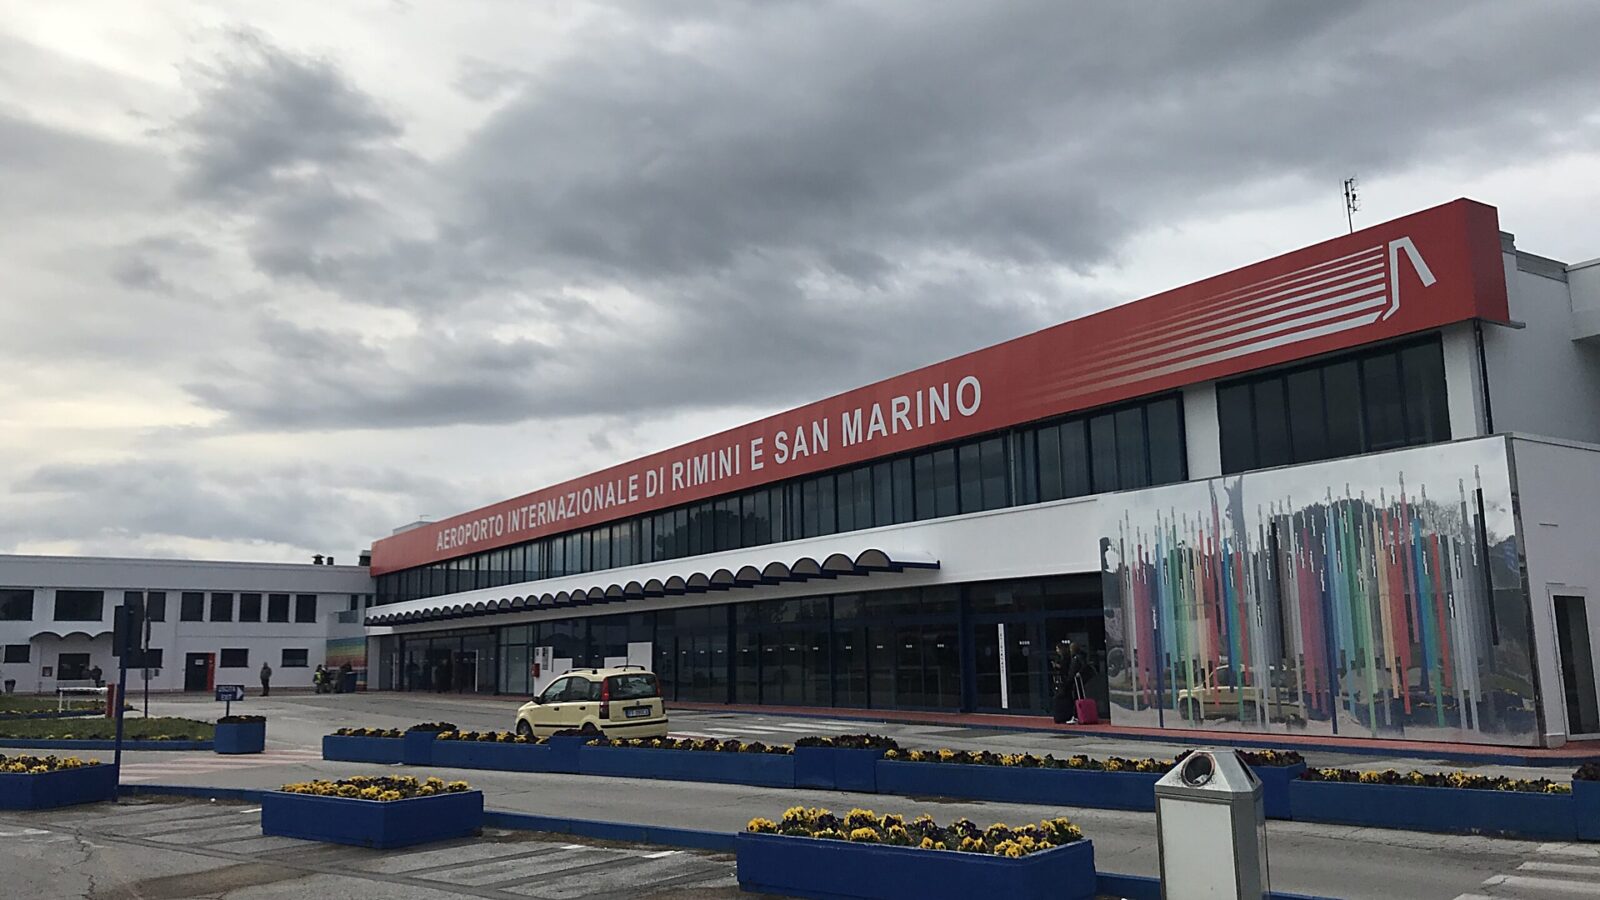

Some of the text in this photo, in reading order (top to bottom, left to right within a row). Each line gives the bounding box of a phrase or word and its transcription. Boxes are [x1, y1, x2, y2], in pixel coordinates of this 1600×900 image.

[436, 375, 982, 551] AEROPORTO INTERNAZIONALE DI RIMINI E SAN MARINO
